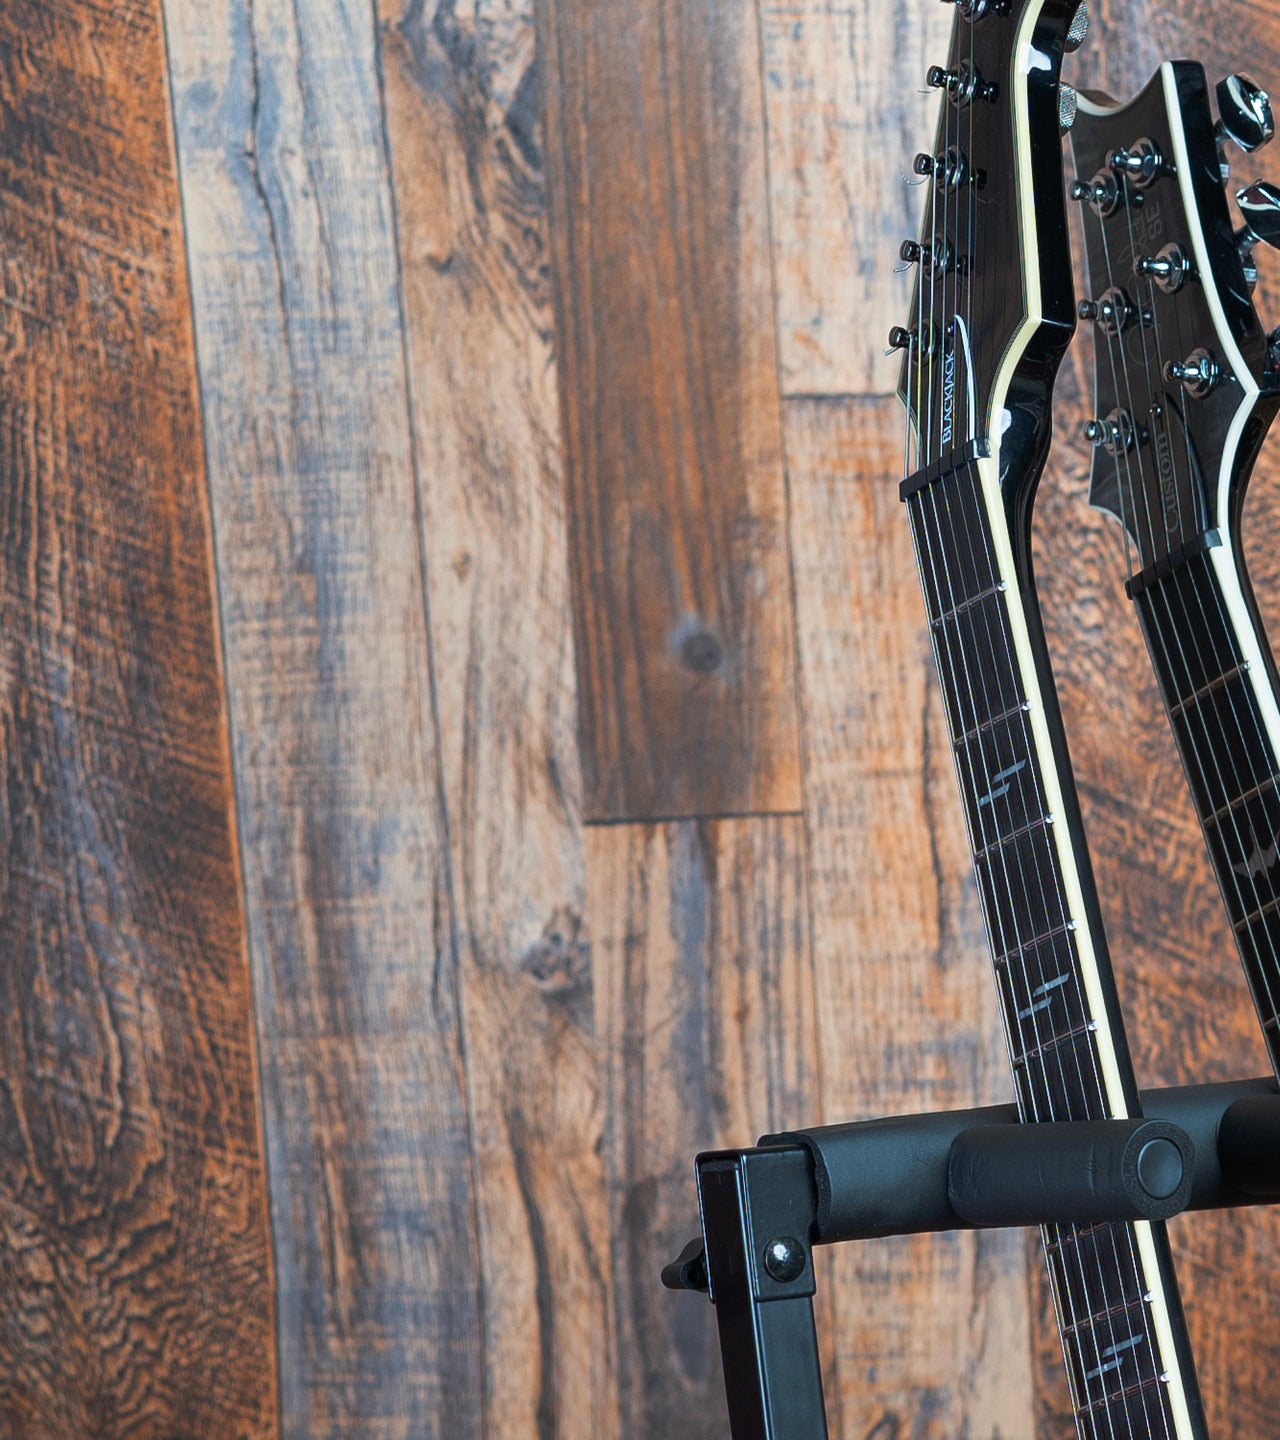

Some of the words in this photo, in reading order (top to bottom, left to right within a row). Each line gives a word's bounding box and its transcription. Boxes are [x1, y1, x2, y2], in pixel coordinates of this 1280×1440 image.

[1147, 202, 1163, 241] SE
[942, 349, 955, 444] BLACKJACK
[1156, 432, 1180, 534] Custom
